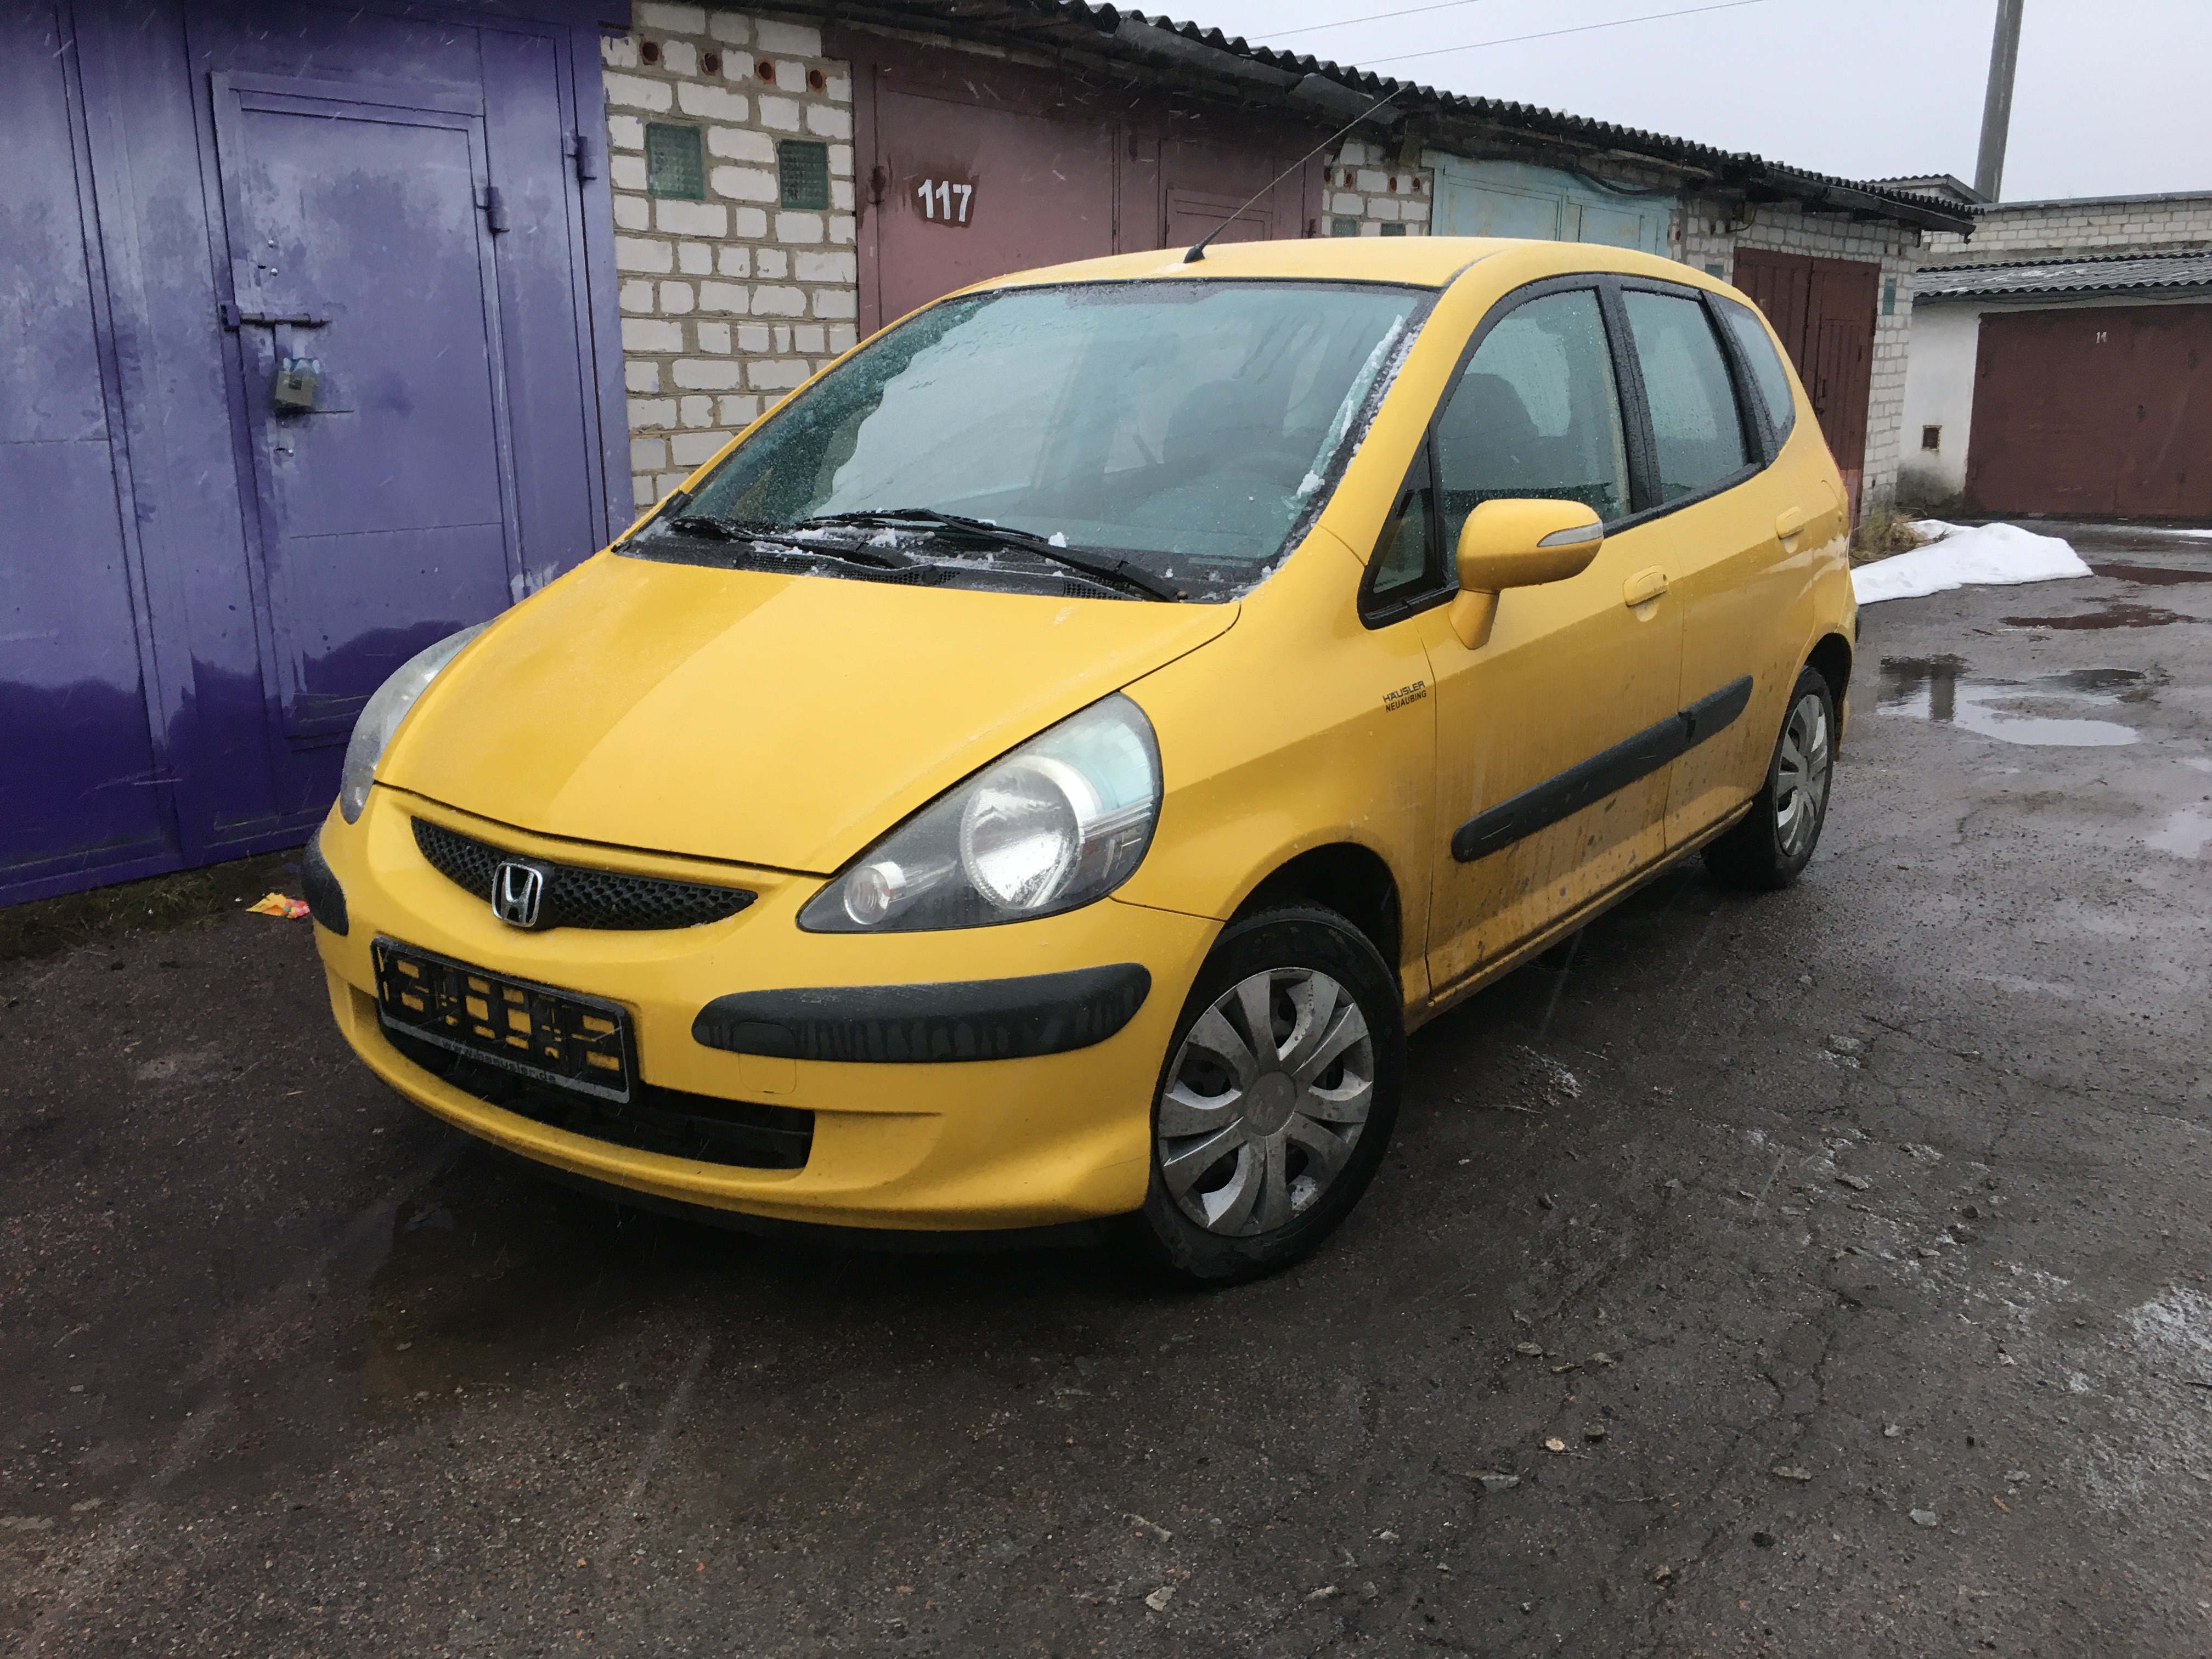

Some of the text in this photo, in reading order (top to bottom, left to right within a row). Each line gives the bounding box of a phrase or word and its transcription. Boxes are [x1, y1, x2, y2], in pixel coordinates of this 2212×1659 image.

[918, 179, 972, 222] 117
[1383, 680, 1425, 703] HÄUSLER
[1386, 690, 1427, 713] NEUAUBING
